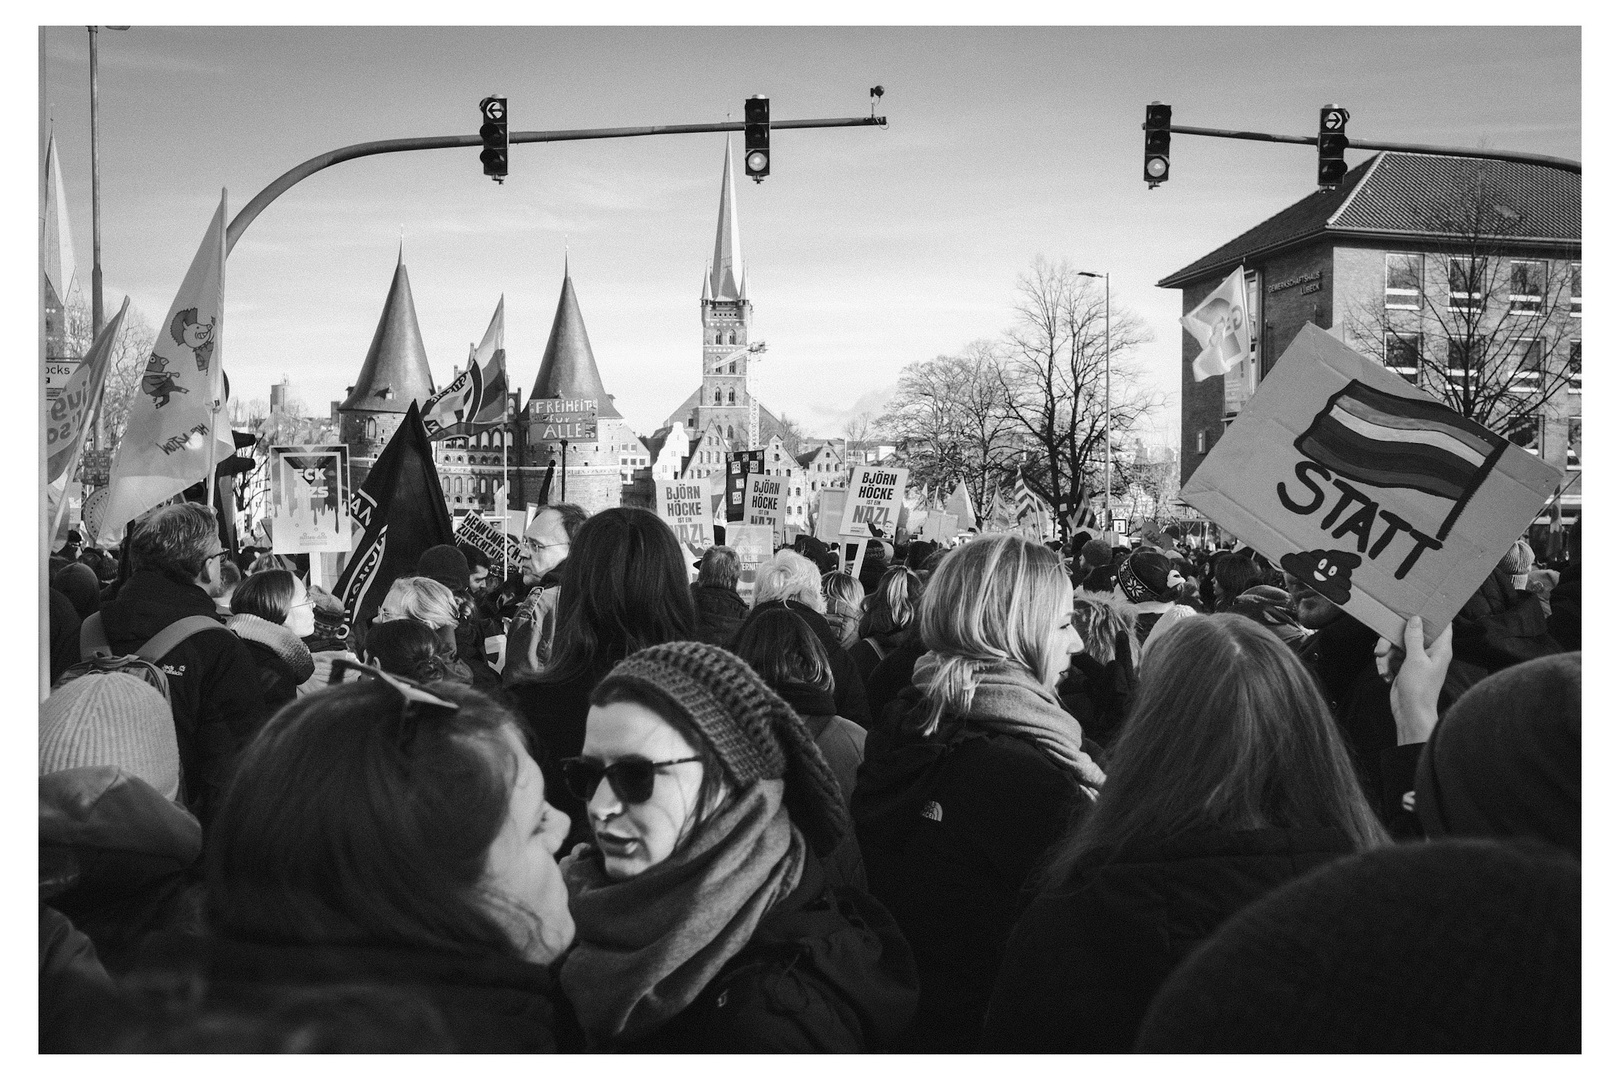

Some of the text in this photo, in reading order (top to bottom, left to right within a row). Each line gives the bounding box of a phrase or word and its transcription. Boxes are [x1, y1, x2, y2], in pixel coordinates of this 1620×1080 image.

[543, 422, 582, 439] ALLE
[293, 468, 327, 480] FCK
[862, 470, 898, 486] BJÖRN
[666, 484, 701, 500] BJÖRN
[753, 479, 780, 495] BJÖRN
[858, 484, 894, 500] HÖCKE
[667, 500, 702, 517] HÖCKE
[752, 494, 778, 510] HÖCKE
[852, 505, 890, 525] NAZI
[1277, 460, 1443, 580] STATT
